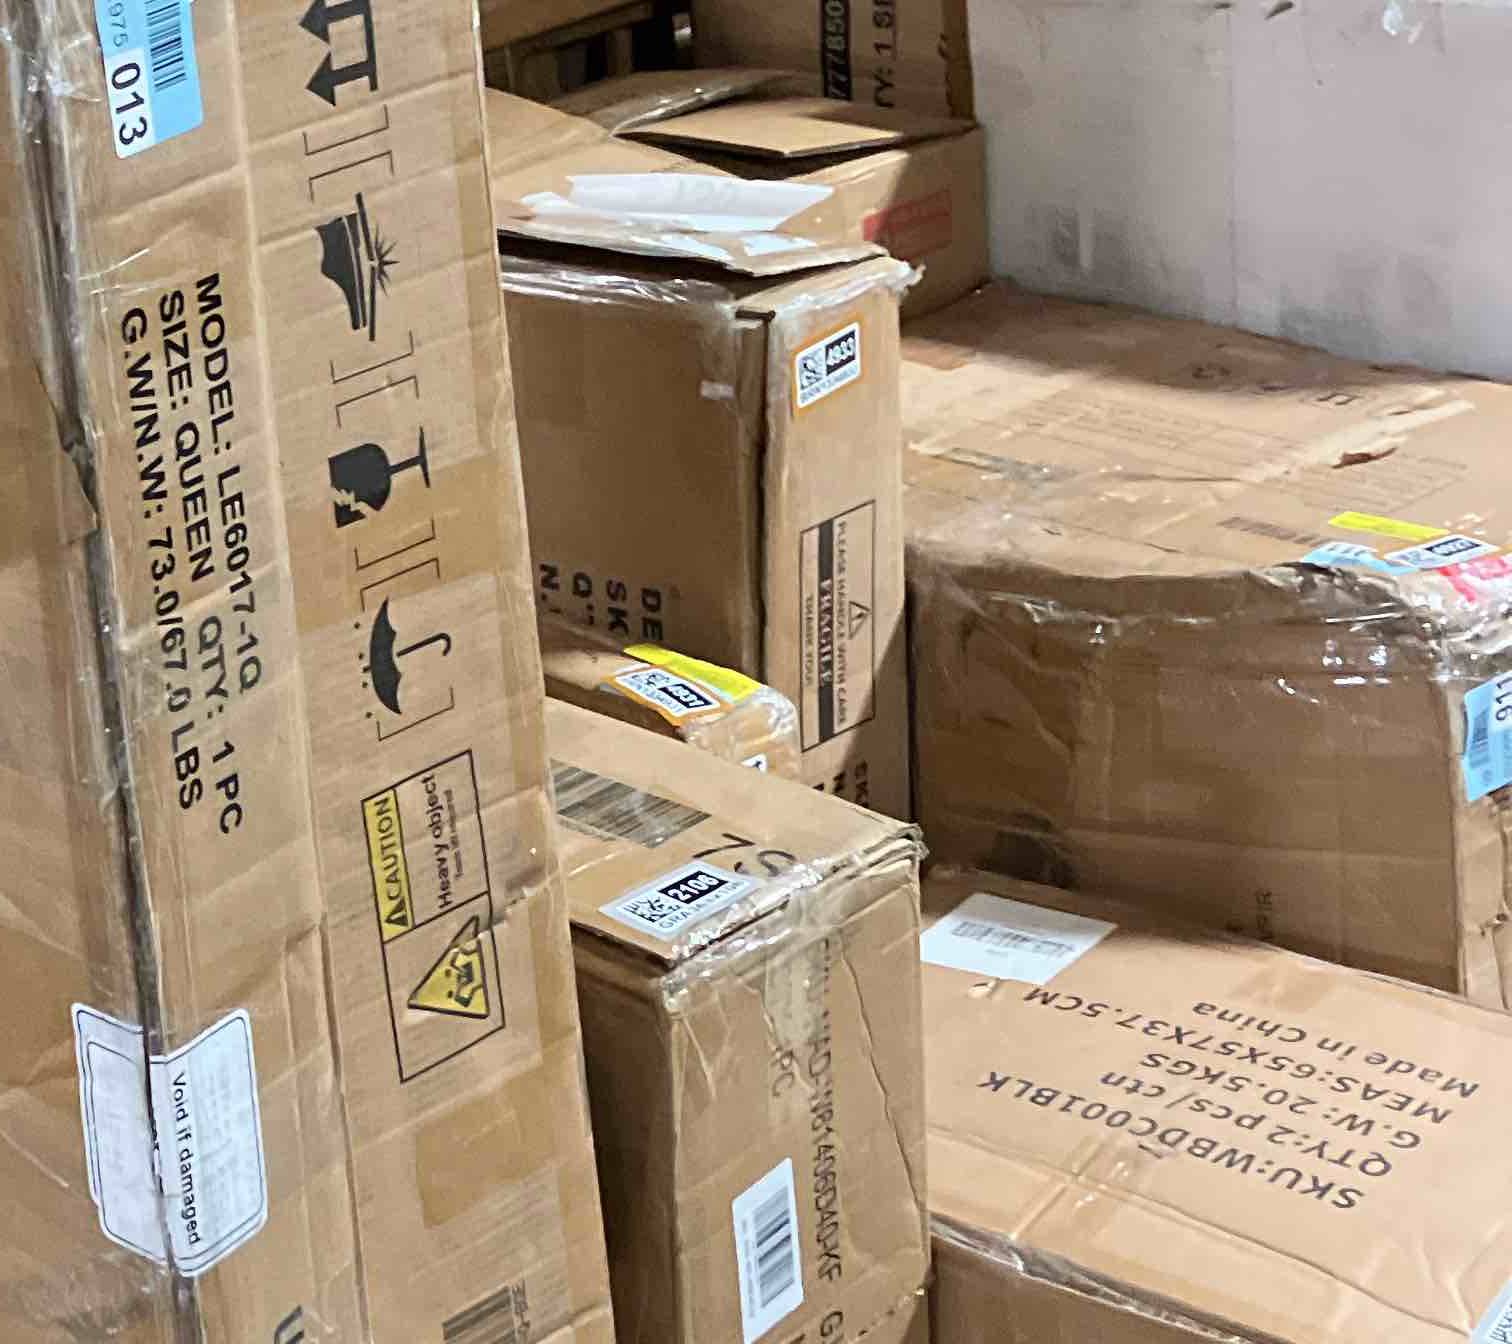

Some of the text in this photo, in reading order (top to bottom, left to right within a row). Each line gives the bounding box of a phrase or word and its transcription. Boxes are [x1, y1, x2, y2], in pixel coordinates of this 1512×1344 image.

[109, 60, 149, 146] 013
[195, 272, 264, 692] MODEL: LE6017-1Q
[157, 289, 244, 836] SIZE: QUEEN QTY: 1 PC
[170, 720, 204, 811] LBS
[369, 797, 403, 907] CAUTION
[420, 773, 454, 911] Heavy object
[669, 874, 726, 902] 2108
[1191, 1000, 1480, 1099] Made in China
[170, 1071, 202, 1246] Void if damaged
